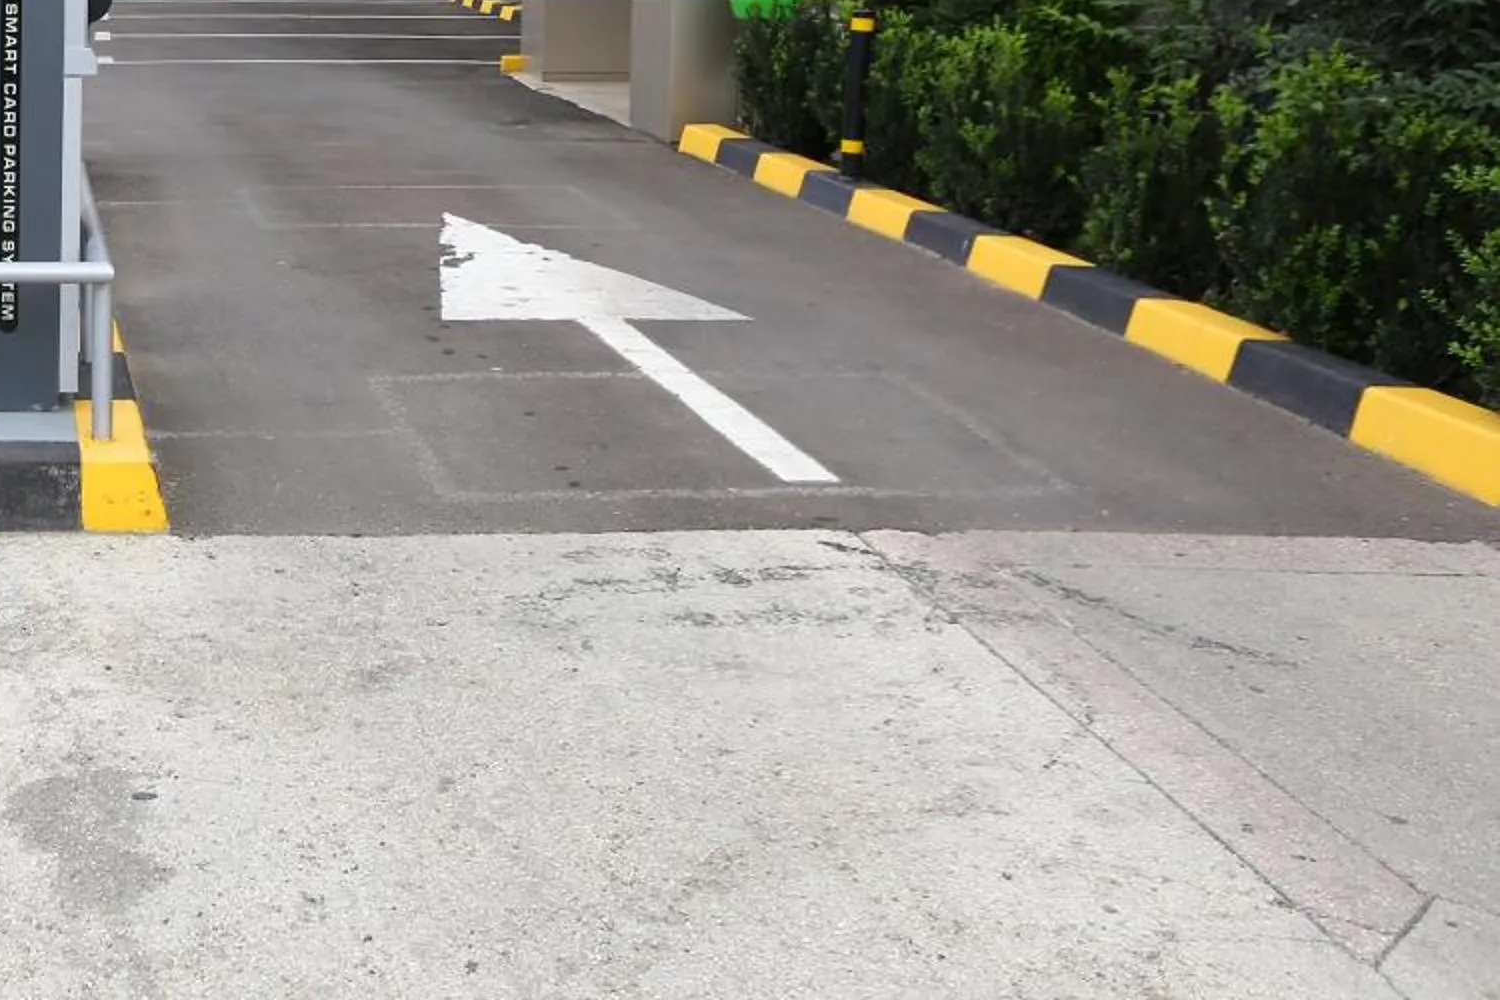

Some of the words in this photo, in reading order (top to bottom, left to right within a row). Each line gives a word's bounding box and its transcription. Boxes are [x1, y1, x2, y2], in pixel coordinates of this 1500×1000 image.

[4, 3, 19, 75] SMART
[3, 83, 18, 138] CARD
[2, 144, 17, 233] PARKING
[1, 239, 16, 321] SYTEM
